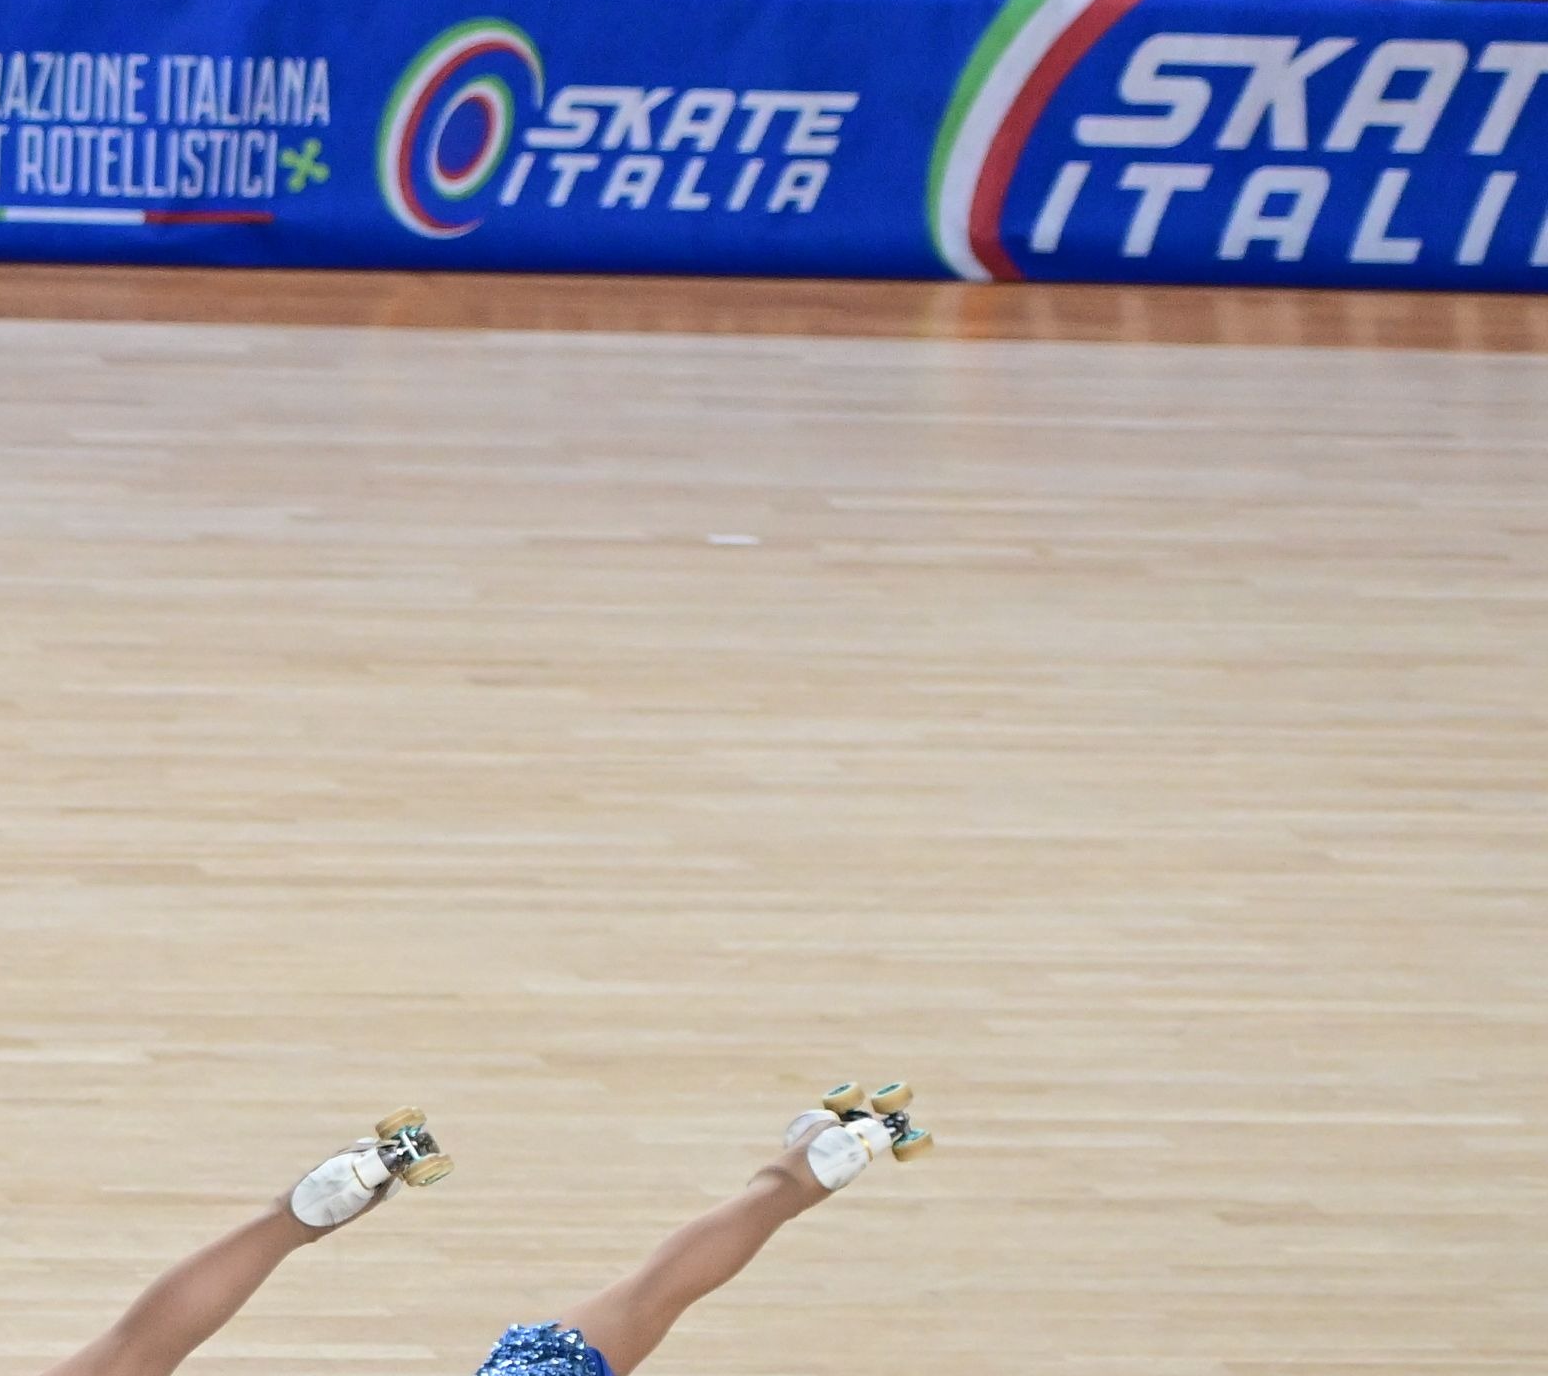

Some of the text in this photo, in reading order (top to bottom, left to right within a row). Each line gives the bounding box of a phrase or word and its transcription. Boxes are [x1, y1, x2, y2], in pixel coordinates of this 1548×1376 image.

[158, 54, 328, 127] ITALIANA
[524, 85, 859, 154] SKATE
[16, 123, 275, 199] ROTELLISTICI
[500, 153, 832, 212] ITALIA
[1029, 160, 1548, 266] ITALI
